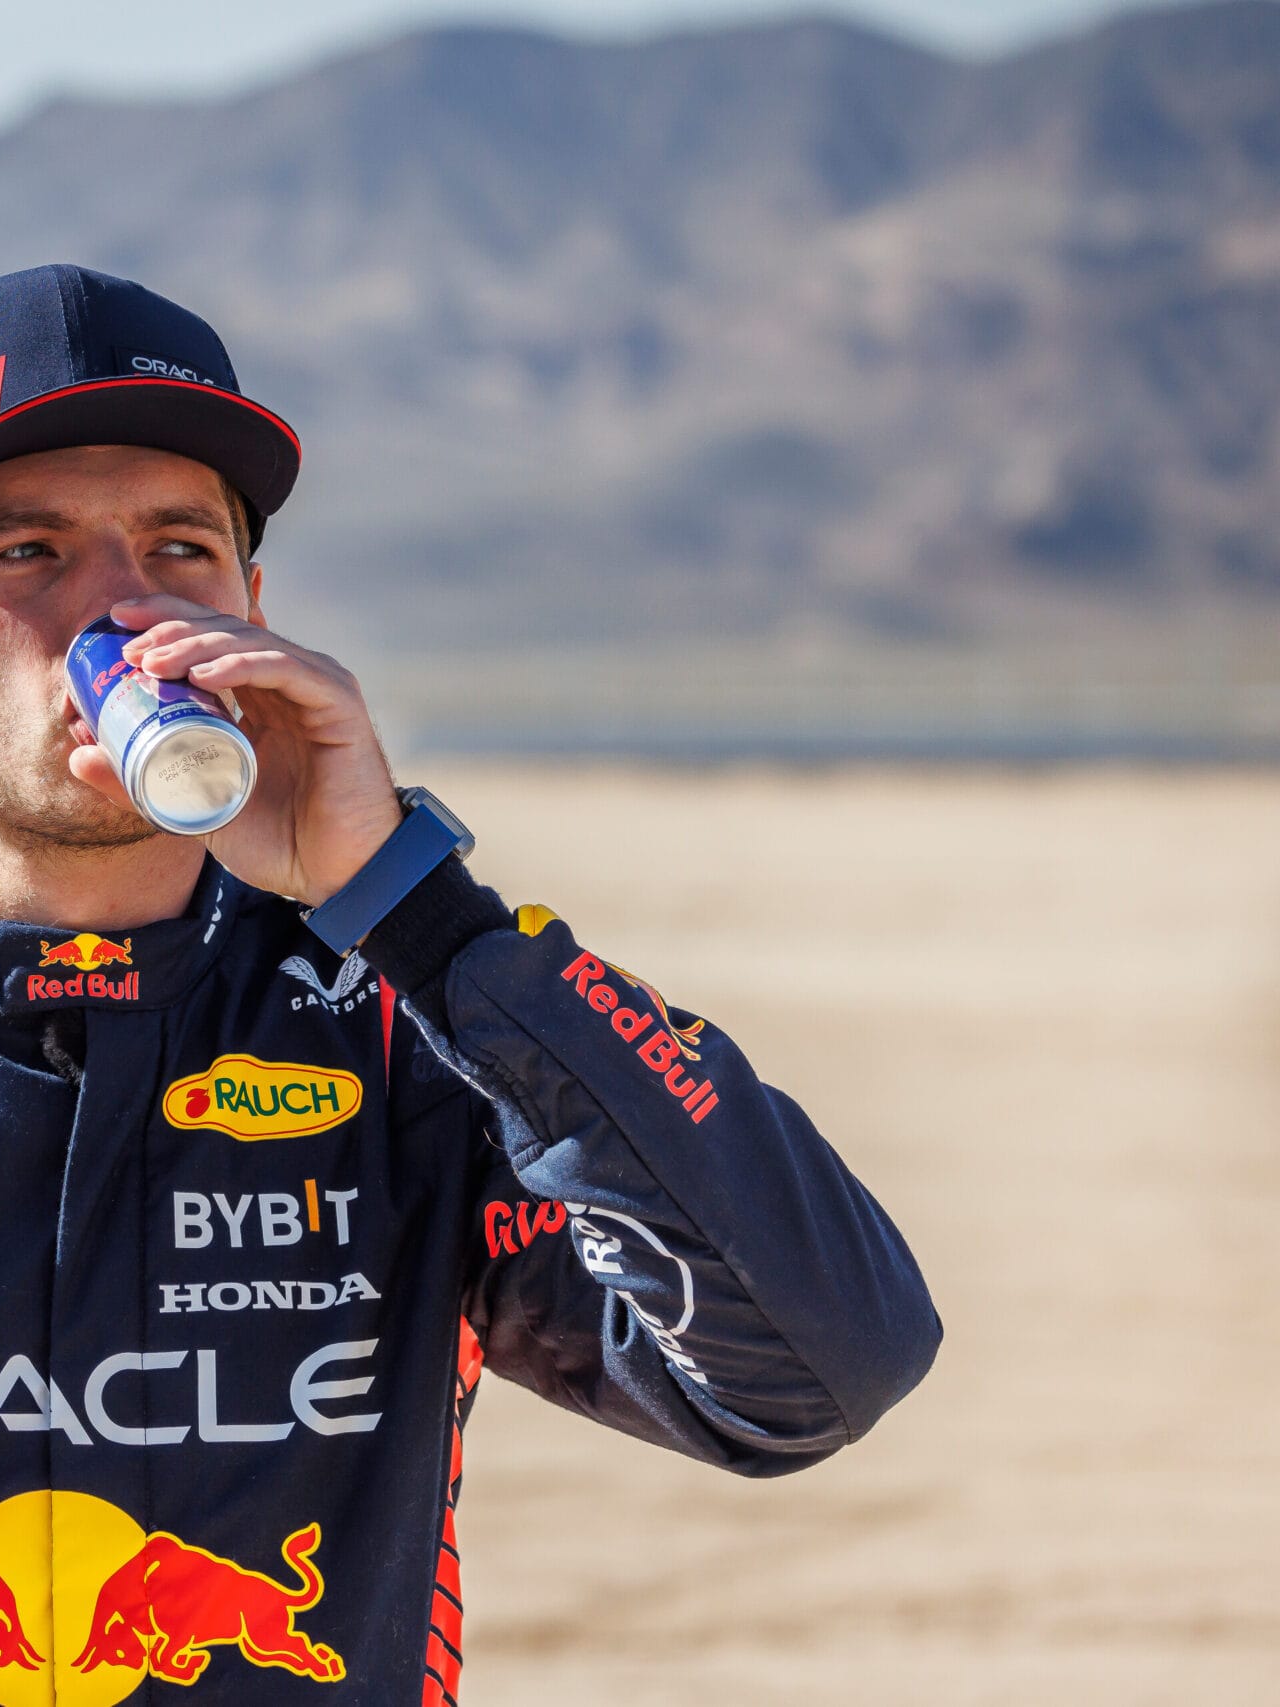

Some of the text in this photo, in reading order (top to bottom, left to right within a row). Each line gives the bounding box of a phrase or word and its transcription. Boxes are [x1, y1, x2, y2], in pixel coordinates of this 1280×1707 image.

[27, 972, 140, 1001] Red Bull
[561, 950, 720, 1125] Red Bull
[215, 1077, 340, 1116] RAUCH
[173, 1179, 359, 1249] BYBIT
[158, 1272, 382, 1313] HONDA
